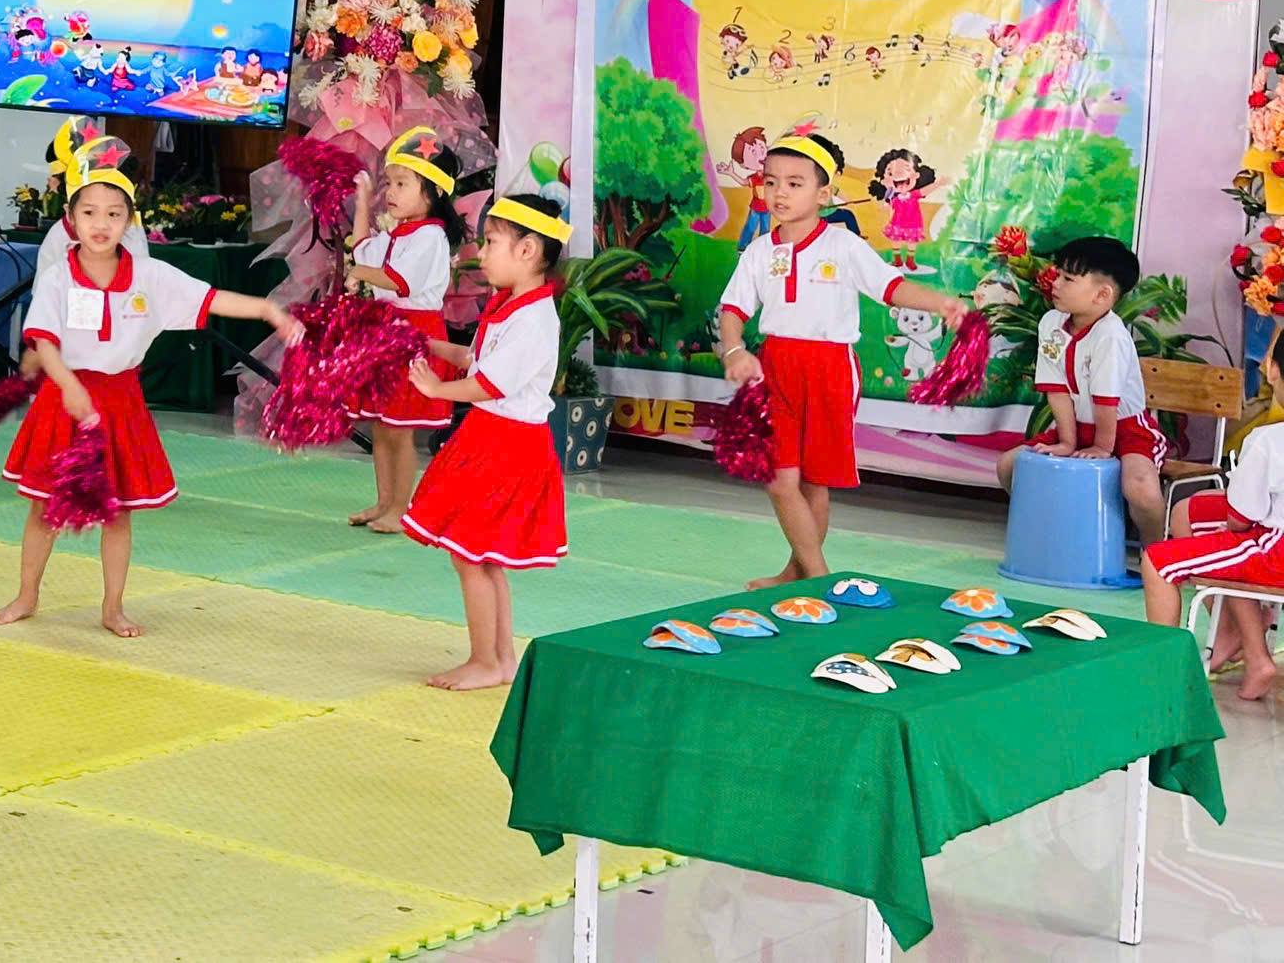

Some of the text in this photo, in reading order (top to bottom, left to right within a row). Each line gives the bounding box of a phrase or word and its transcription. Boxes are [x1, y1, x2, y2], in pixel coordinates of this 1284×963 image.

[732, 6, 743, 23] 1
[779, 29, 792, 44] 2
[614, 398, 695, 434] OVE
